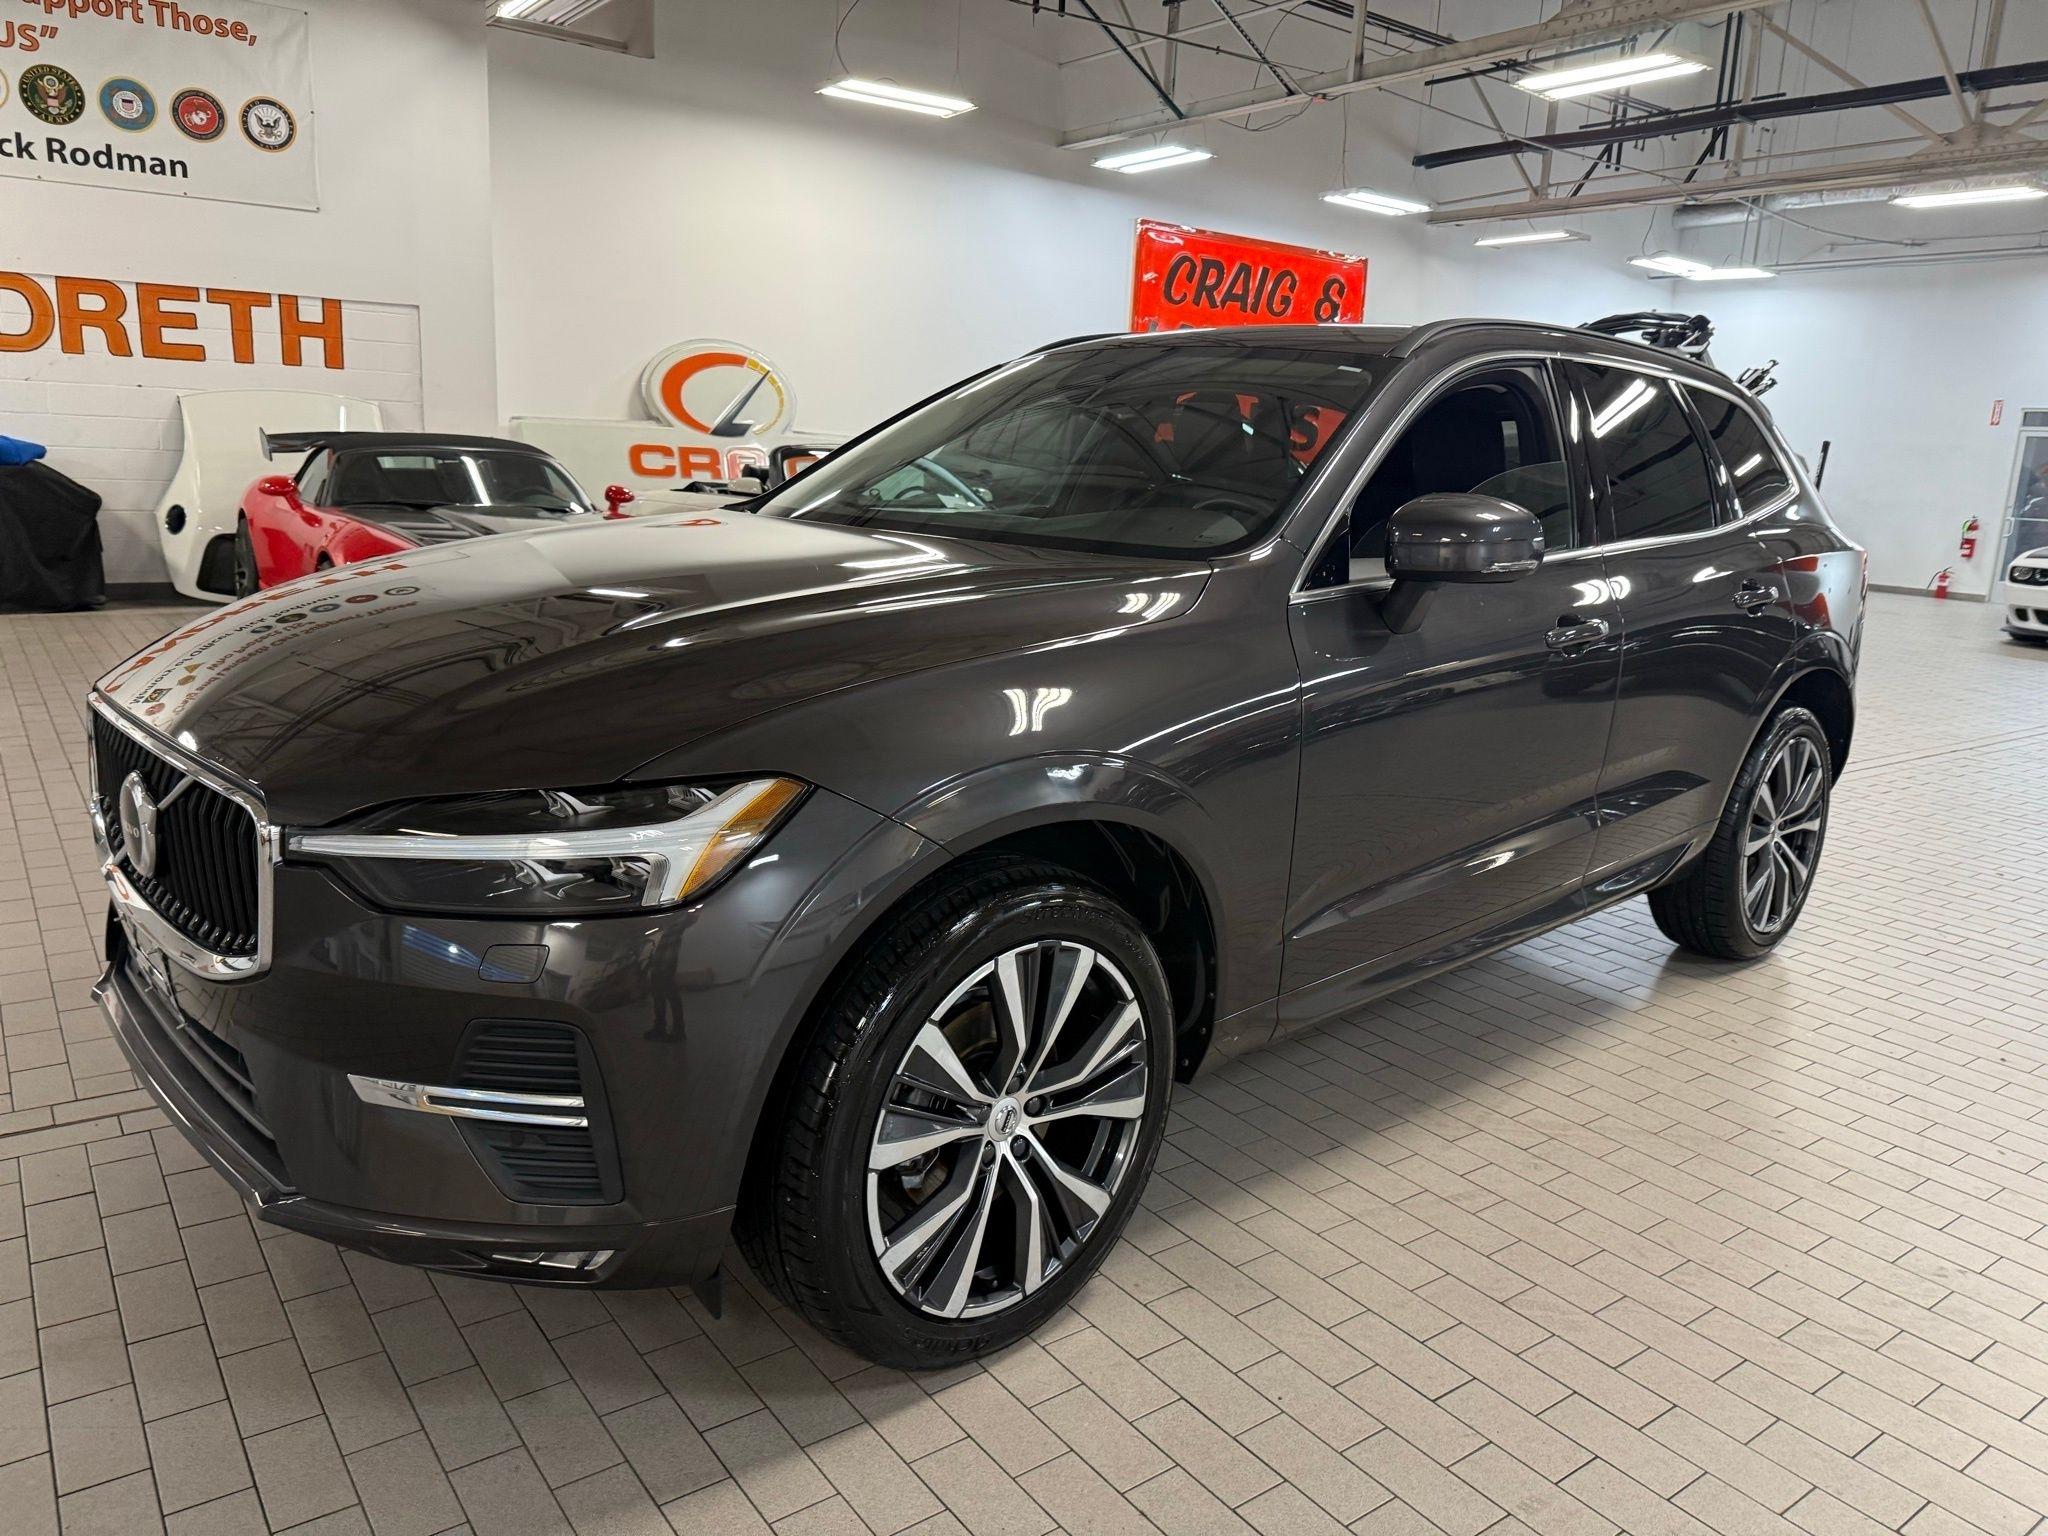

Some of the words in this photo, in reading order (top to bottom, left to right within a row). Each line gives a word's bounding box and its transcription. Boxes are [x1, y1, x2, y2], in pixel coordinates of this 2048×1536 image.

[148, 0, 257, 46] Those,
[39, 112, 71, 126] ARMY
[45, 137, 189, 178] Rodman
[1163, 254, 1298, 317] CRAIG
[1313, 276, 1346, 323] &
